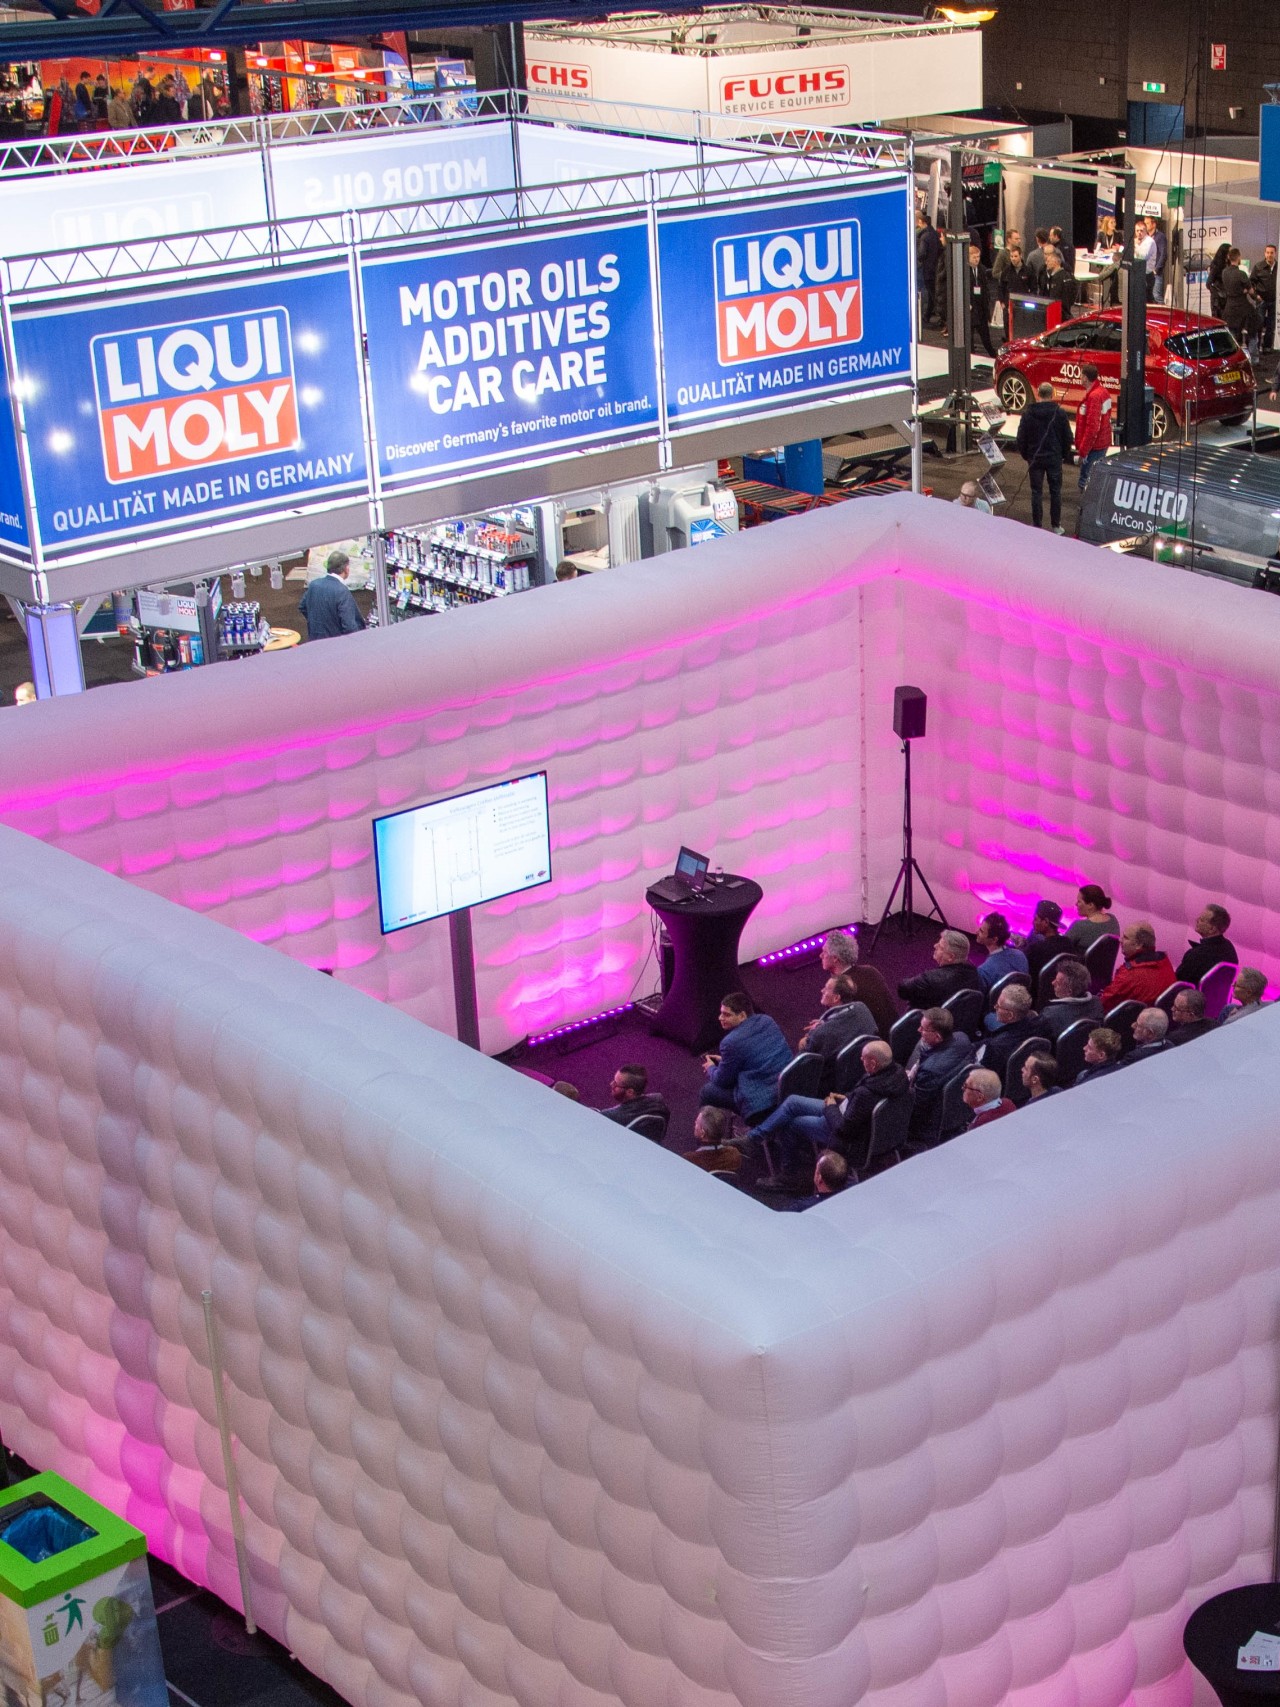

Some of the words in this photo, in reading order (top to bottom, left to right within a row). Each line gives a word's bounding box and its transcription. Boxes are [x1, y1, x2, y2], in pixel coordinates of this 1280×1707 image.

[527, 64, 589, 89] CHS
[723, 69, 847, 101] FUCHS
[724, 100, 777, 115] SERVICE
[779, 92, 848, 109] EQUIPMENT
[399, 265, 533, 327] MOTOR
[540, 253, 621, 302] OILS
[722, 226, 854, 297] LIQUI
[417, 300, 611, 371] ADDITIVES
[724, 285, 859, 358] MOLY
[103, 315, 283, 403] LIQUI
[427, 368, 506, 416] CAR
[511, 347, 609, 404] CARE
[677, 373, 756, 407] QUALITÄT
[758, 365, 804, 391] MADE
[807, 361, 824, 380] IN
[827, 347, 903, 377] GERMANY
[1060, 363, 1081, 379] 400
[112, 384, 292, 473] MOLY
[385, 436, 441, 462] Discover
[442, 421, 510, 457] Germany's
[509, 412, 558, 438] favorite
[559, 406, 596, 429] motor
[597, 401, 612, 420] oil
[614, 395, 652, 417] brand.
[0, 514, 23, 530] rand.
[53, 490, 157, 532] QUALITÄT
[163, 478, 224, 514] MADE
[229, 471, 251, 498] IN
[260, 452, 355, 489] GERMANY
[1111, 511, 1145, 532] AirCon
[1113, 478, 1189, 522] WAECO
[177, 600, 196, 609] LIQUI
[177, 608, 197, 616] MOLY
